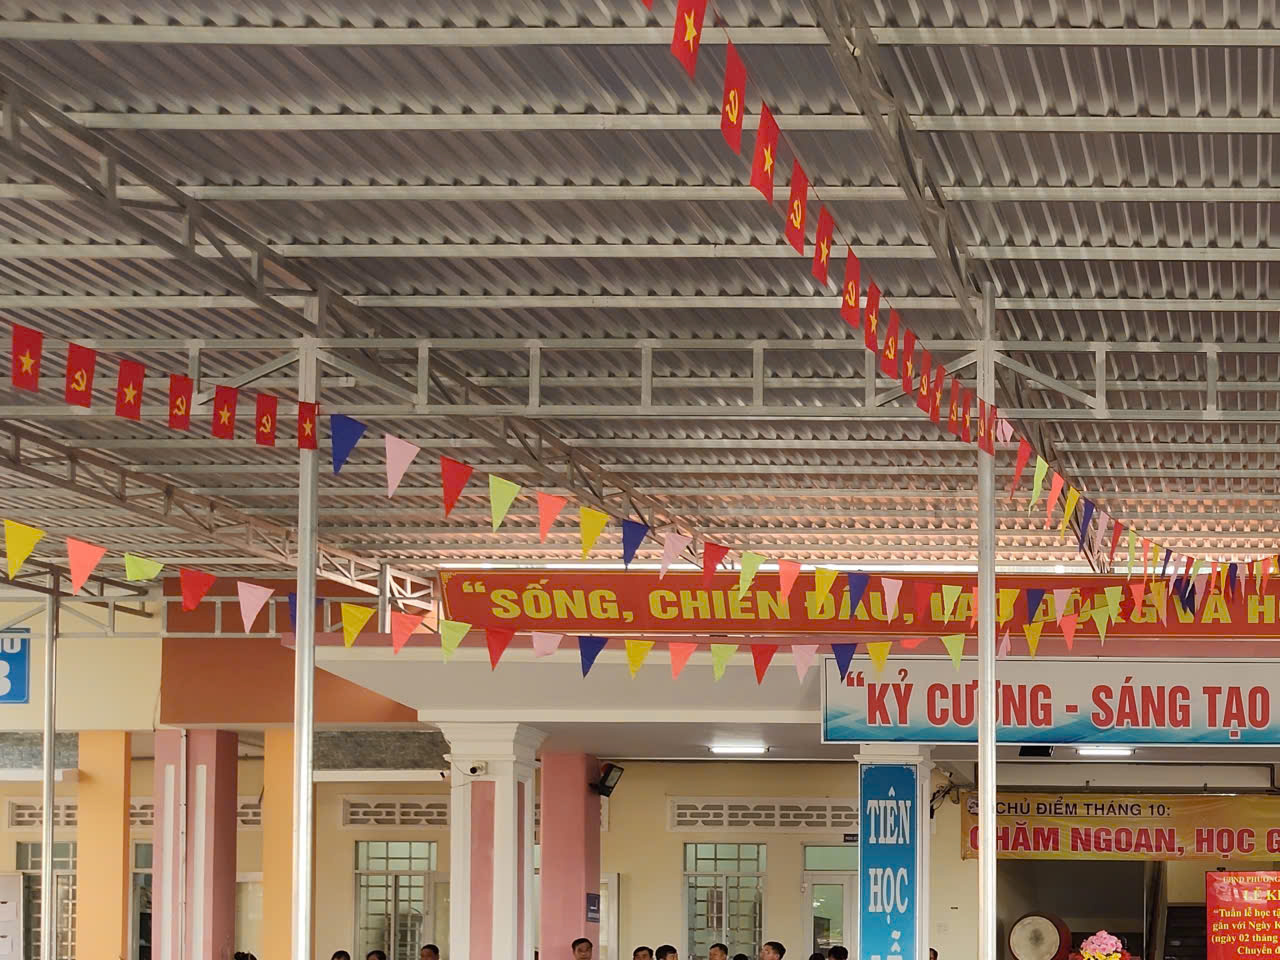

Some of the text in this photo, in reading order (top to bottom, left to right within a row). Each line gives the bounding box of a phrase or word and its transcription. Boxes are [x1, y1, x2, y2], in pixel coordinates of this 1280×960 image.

[462, 578, 634, 623] “SỐNG,
[927, 680, 1053, 727] CƯNG
[1091, 676, 1190, 728] SÁNG
[1203, 686, 1270, 738] TẠO
[866, 786, 912, 844] TIÊN
[1036, 796, 1077, 815] ĐIỂM
[1083, 800, 1142, 816] THÁNG
[1148, 804, 1171, 816] 10:
[1070, 826, 1185, 857] NGOAN,
[1195, 827, 1255, 860] HỌC
[868, 867, 909, 925] HỌC
